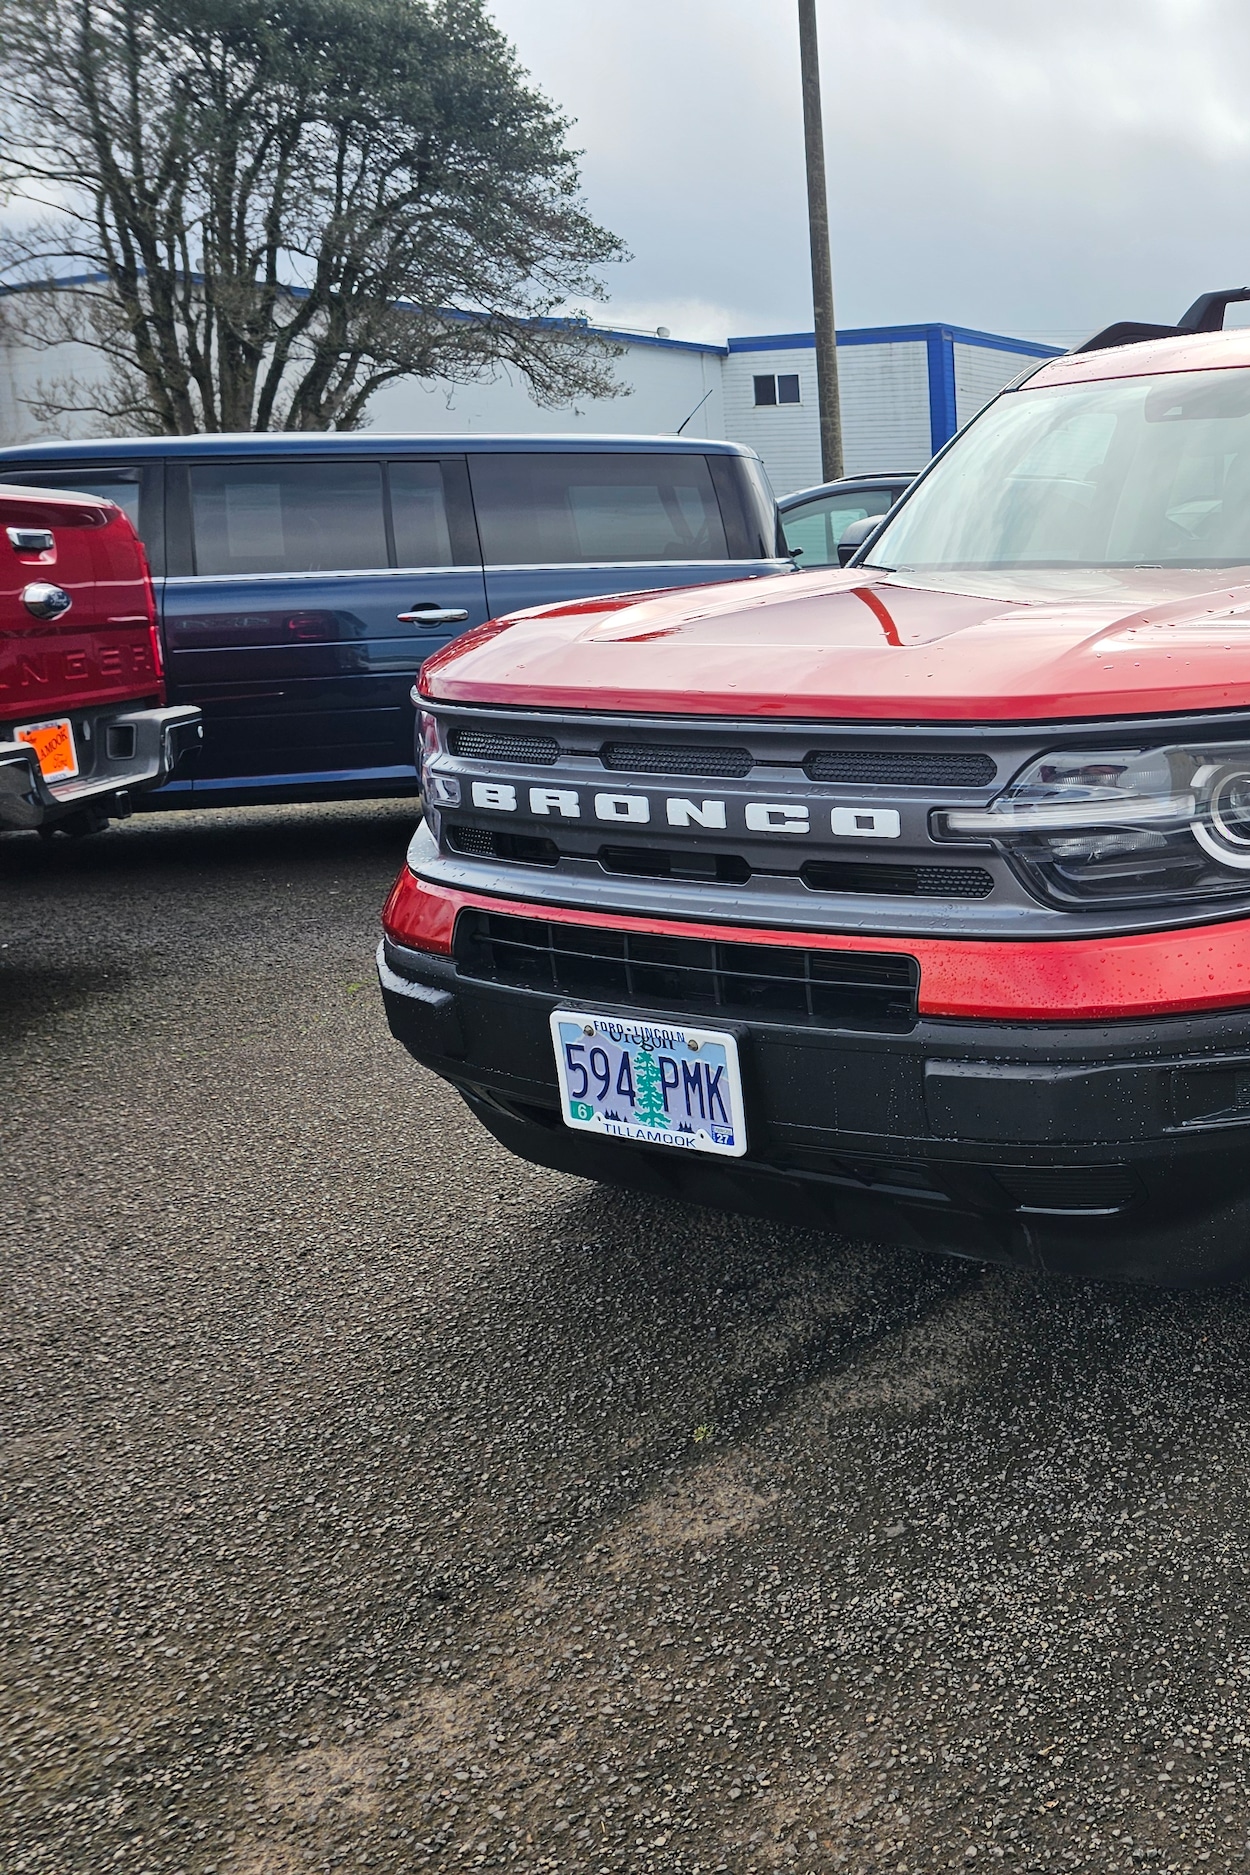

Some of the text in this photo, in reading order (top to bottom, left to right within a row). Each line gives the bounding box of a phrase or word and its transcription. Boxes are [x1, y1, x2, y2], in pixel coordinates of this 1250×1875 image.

[0, 646, 152, 689] NGER
[471, 781, 901, 838] BRONCO
[594, 1020, 686, 1043] FORD LINCOLN
[565, 1043, 728, 1124] 594 PMK
[577, 1103, 588, 1120] 6
[603, 1122, 697, 1149] TILLAMOOK
[716, 1133, 729, 1145] 27
